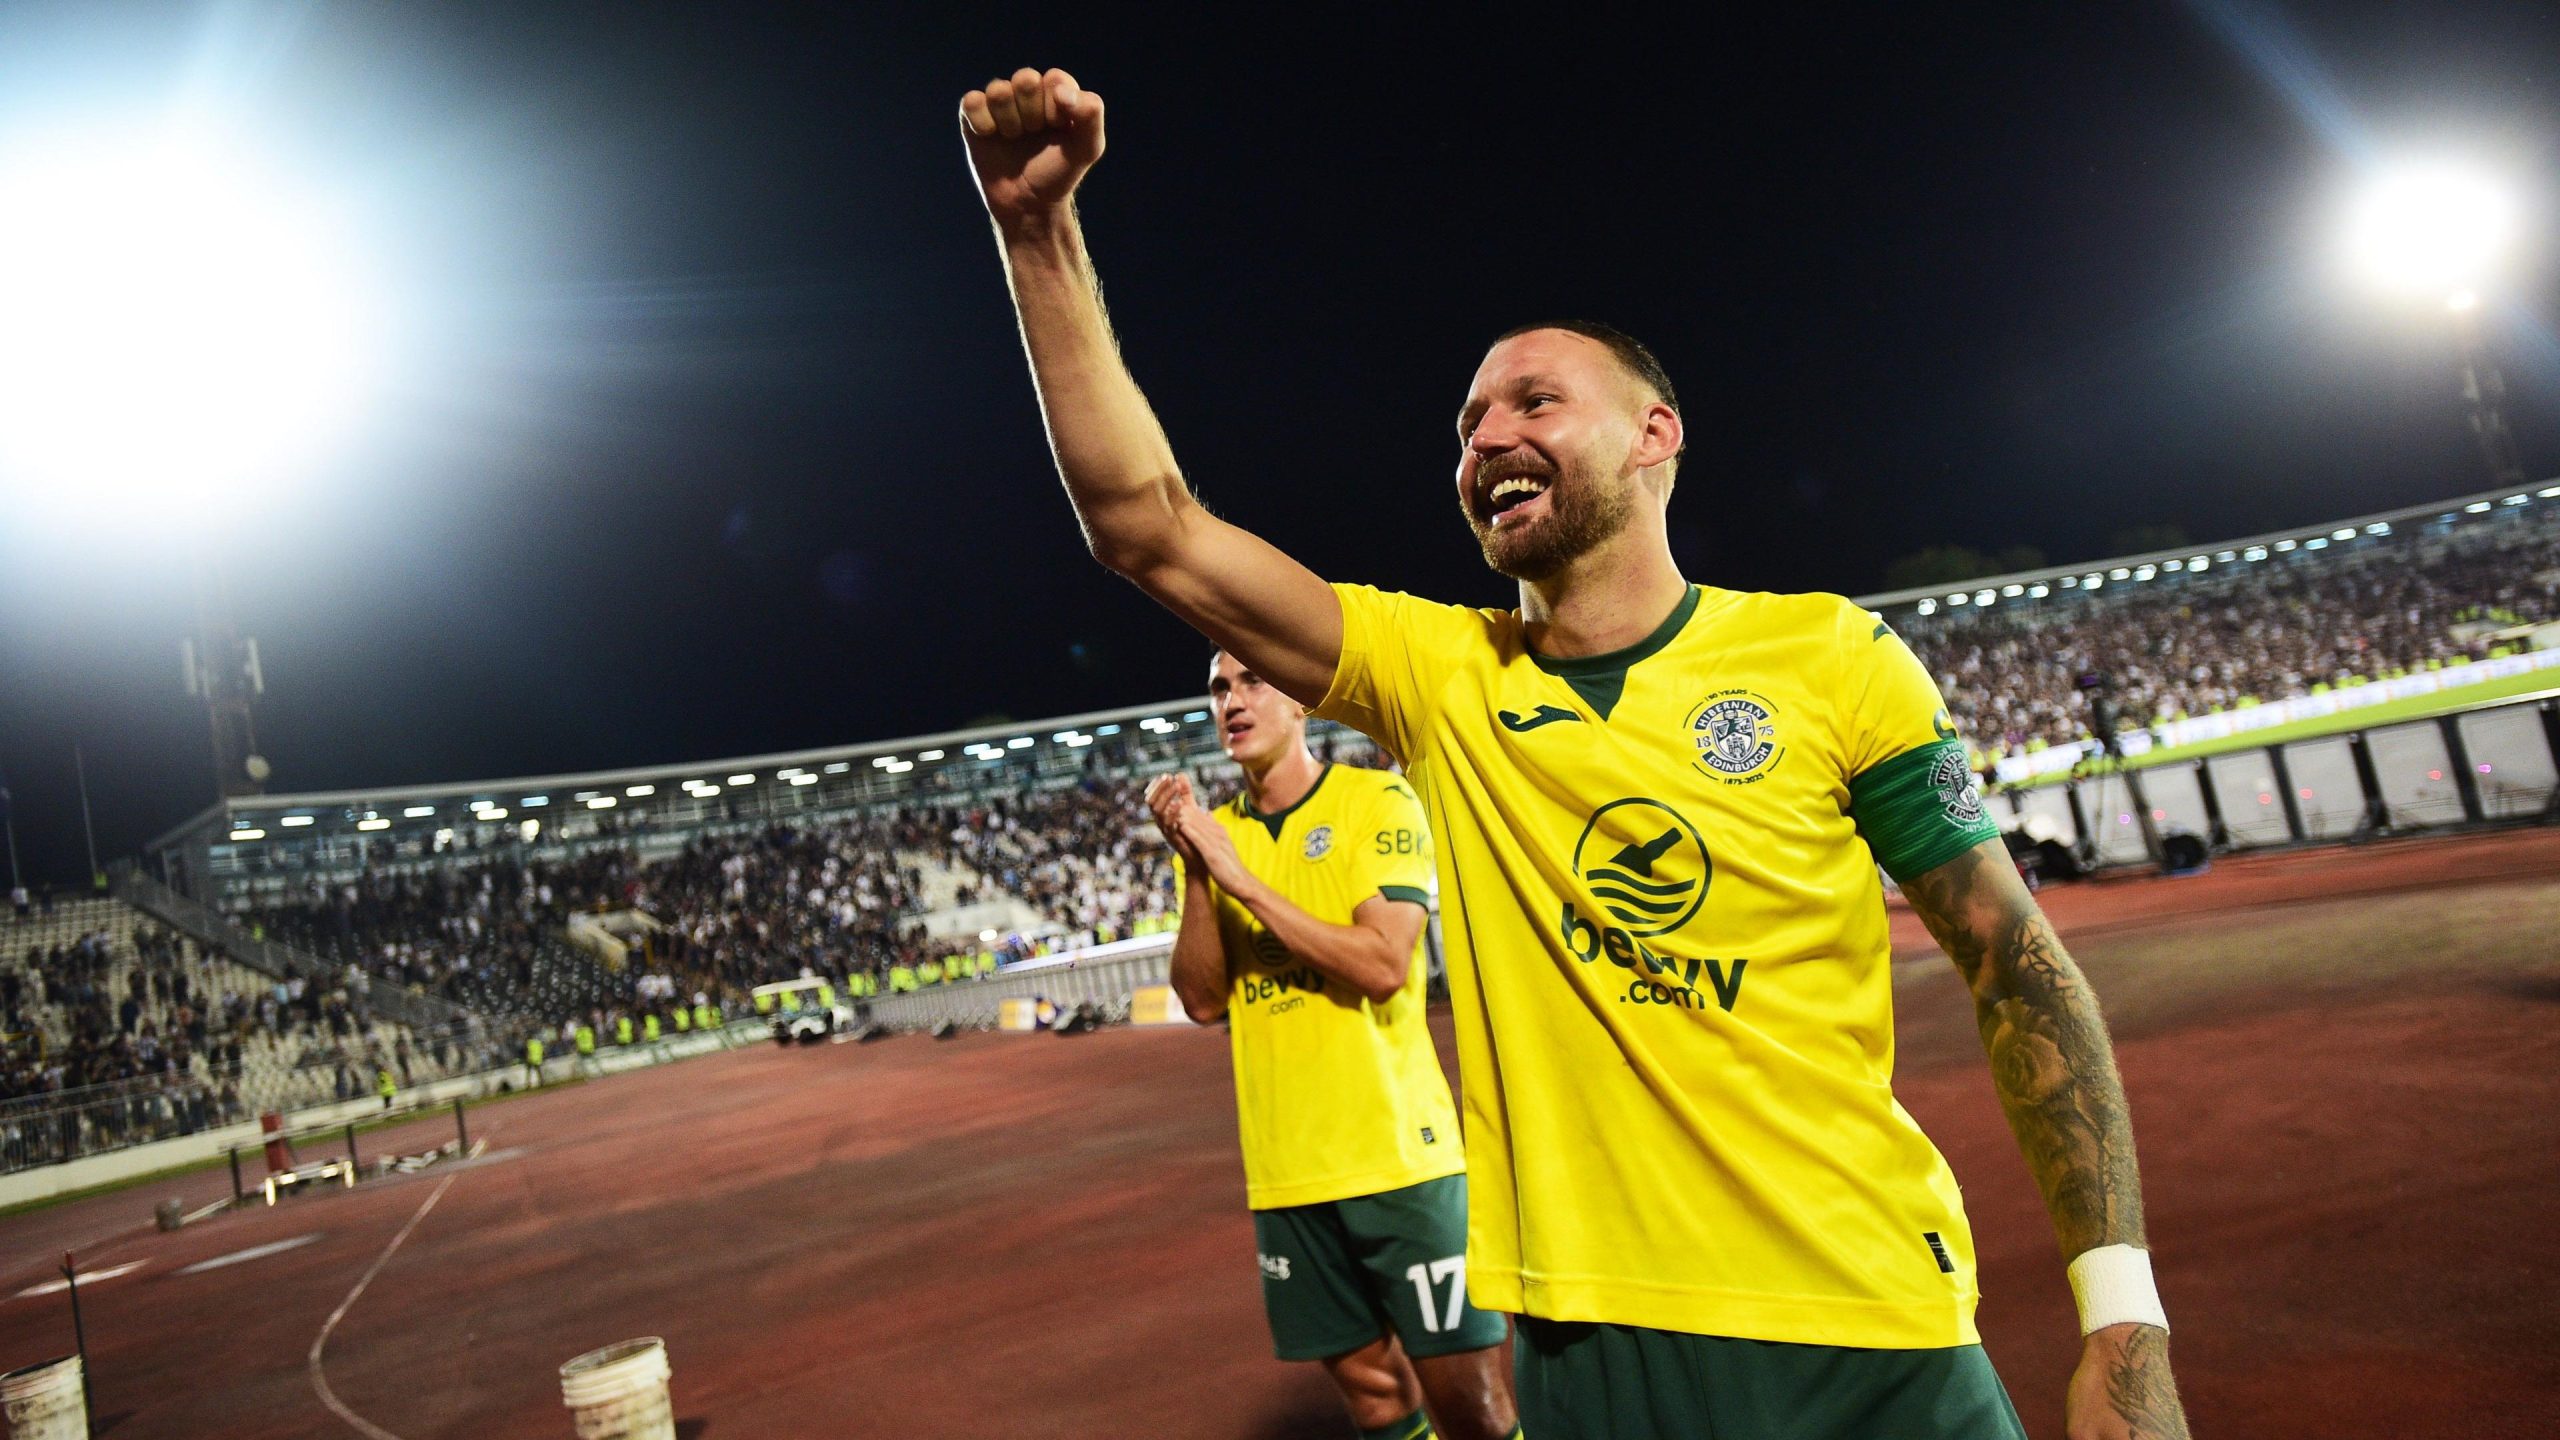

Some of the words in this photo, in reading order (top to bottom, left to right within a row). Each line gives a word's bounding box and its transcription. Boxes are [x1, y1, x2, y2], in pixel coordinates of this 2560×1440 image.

[1697, 701, 1764, 728] HIBERNIAN
[1696, 735, 1711, 748] 18
[1758, 725, 1774, 736] 75
[1708, 746, 1769, 772] EDINBURGH
[1723, 773, 1765, 785] 1875-2025
[1619, 979, 1705, 1010] .com
[1406, 1254, 1466, 1333] 17
